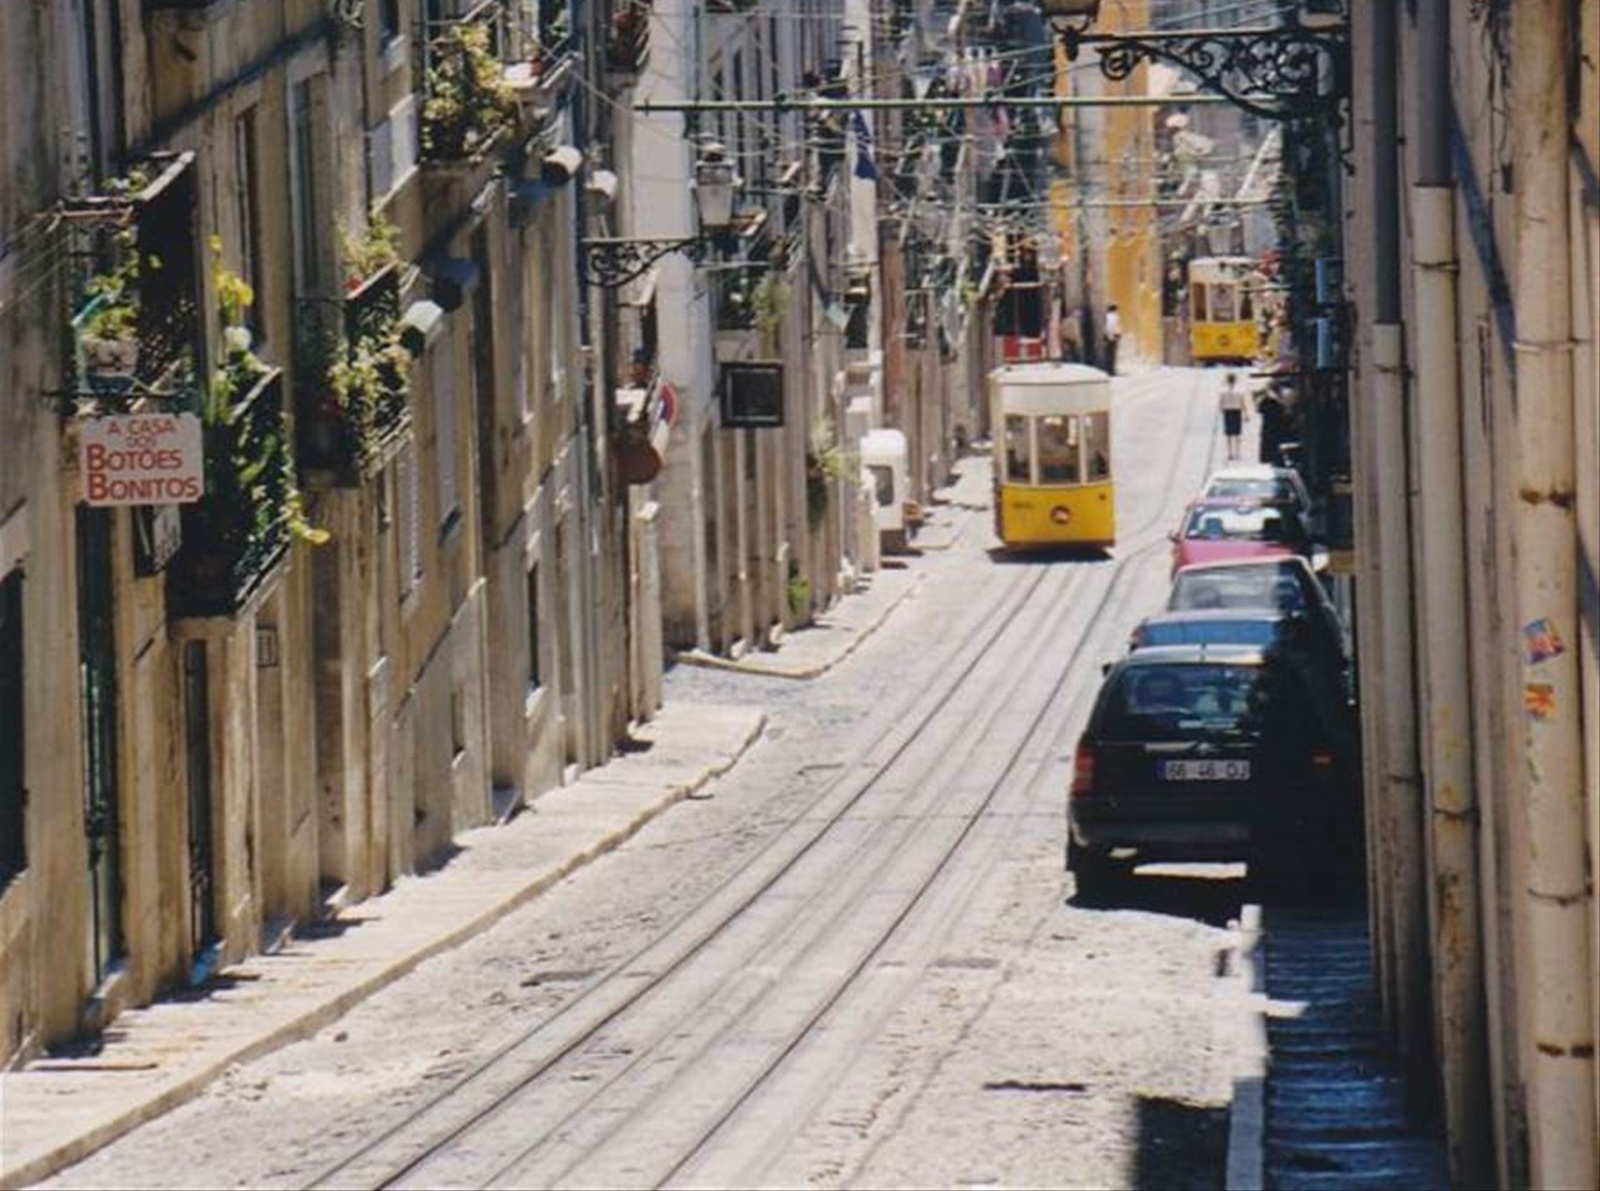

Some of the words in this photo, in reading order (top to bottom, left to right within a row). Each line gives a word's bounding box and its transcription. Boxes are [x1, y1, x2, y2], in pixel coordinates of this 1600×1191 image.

[108, 420, 122, 434] A
[128, 419, 177, 435] CASA
[88, 473, 200, 501] BONITOS
